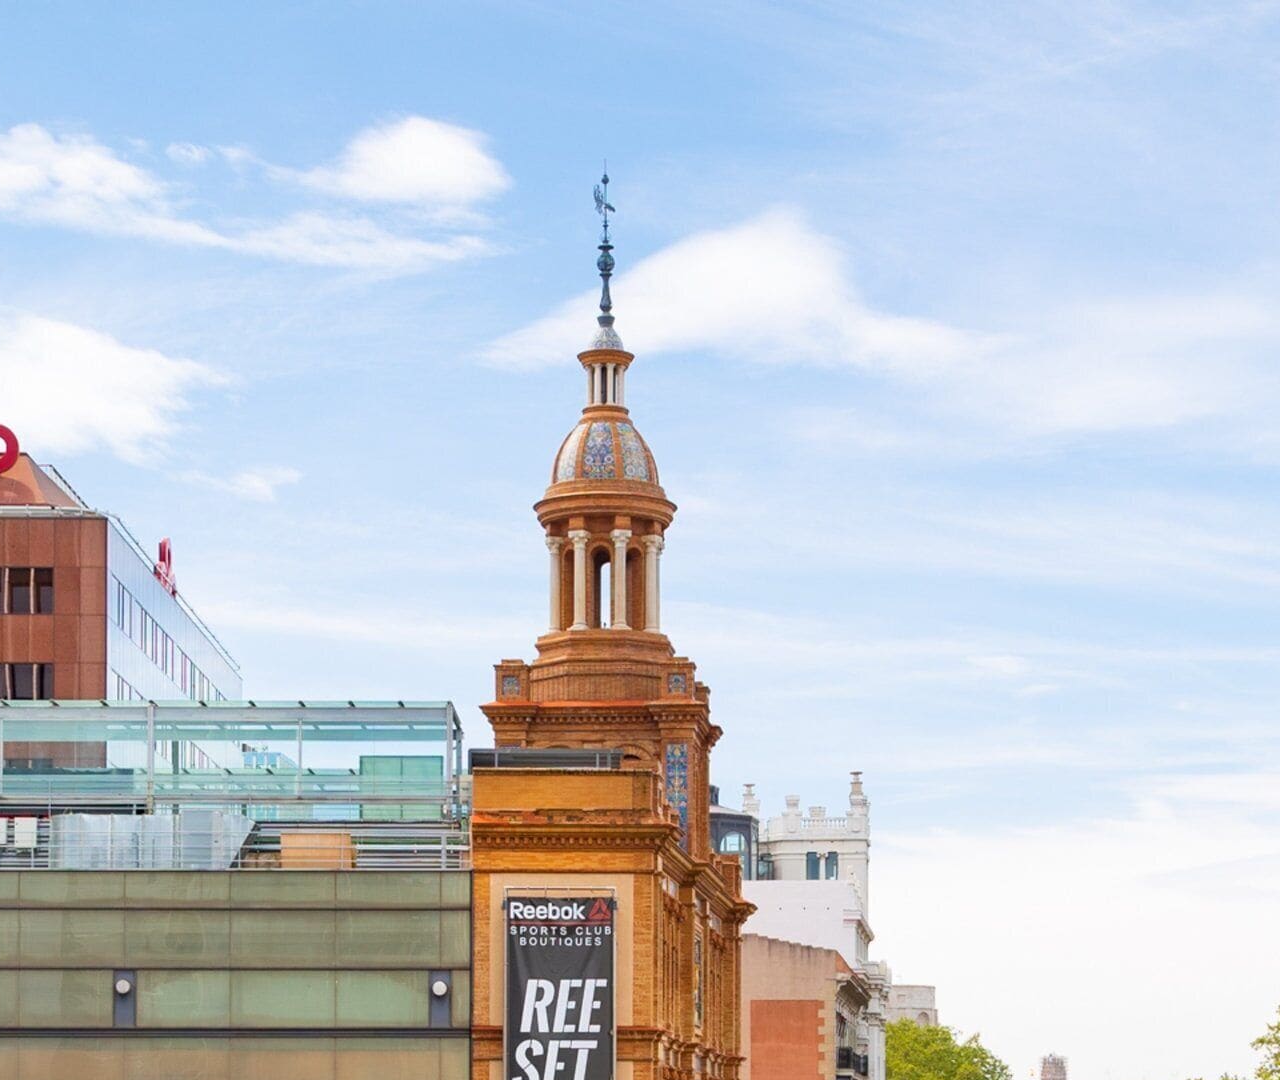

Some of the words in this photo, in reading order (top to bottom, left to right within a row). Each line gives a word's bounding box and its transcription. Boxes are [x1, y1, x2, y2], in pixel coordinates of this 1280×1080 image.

[510, 901, 585, 920] Reebok
[510, 926, 567, 936] SPORTS
[575, 926, 612, 936] CLUB
[519, 936, 603, 947] BOUTIQUES
[520, 979, 608, 1033] REE
